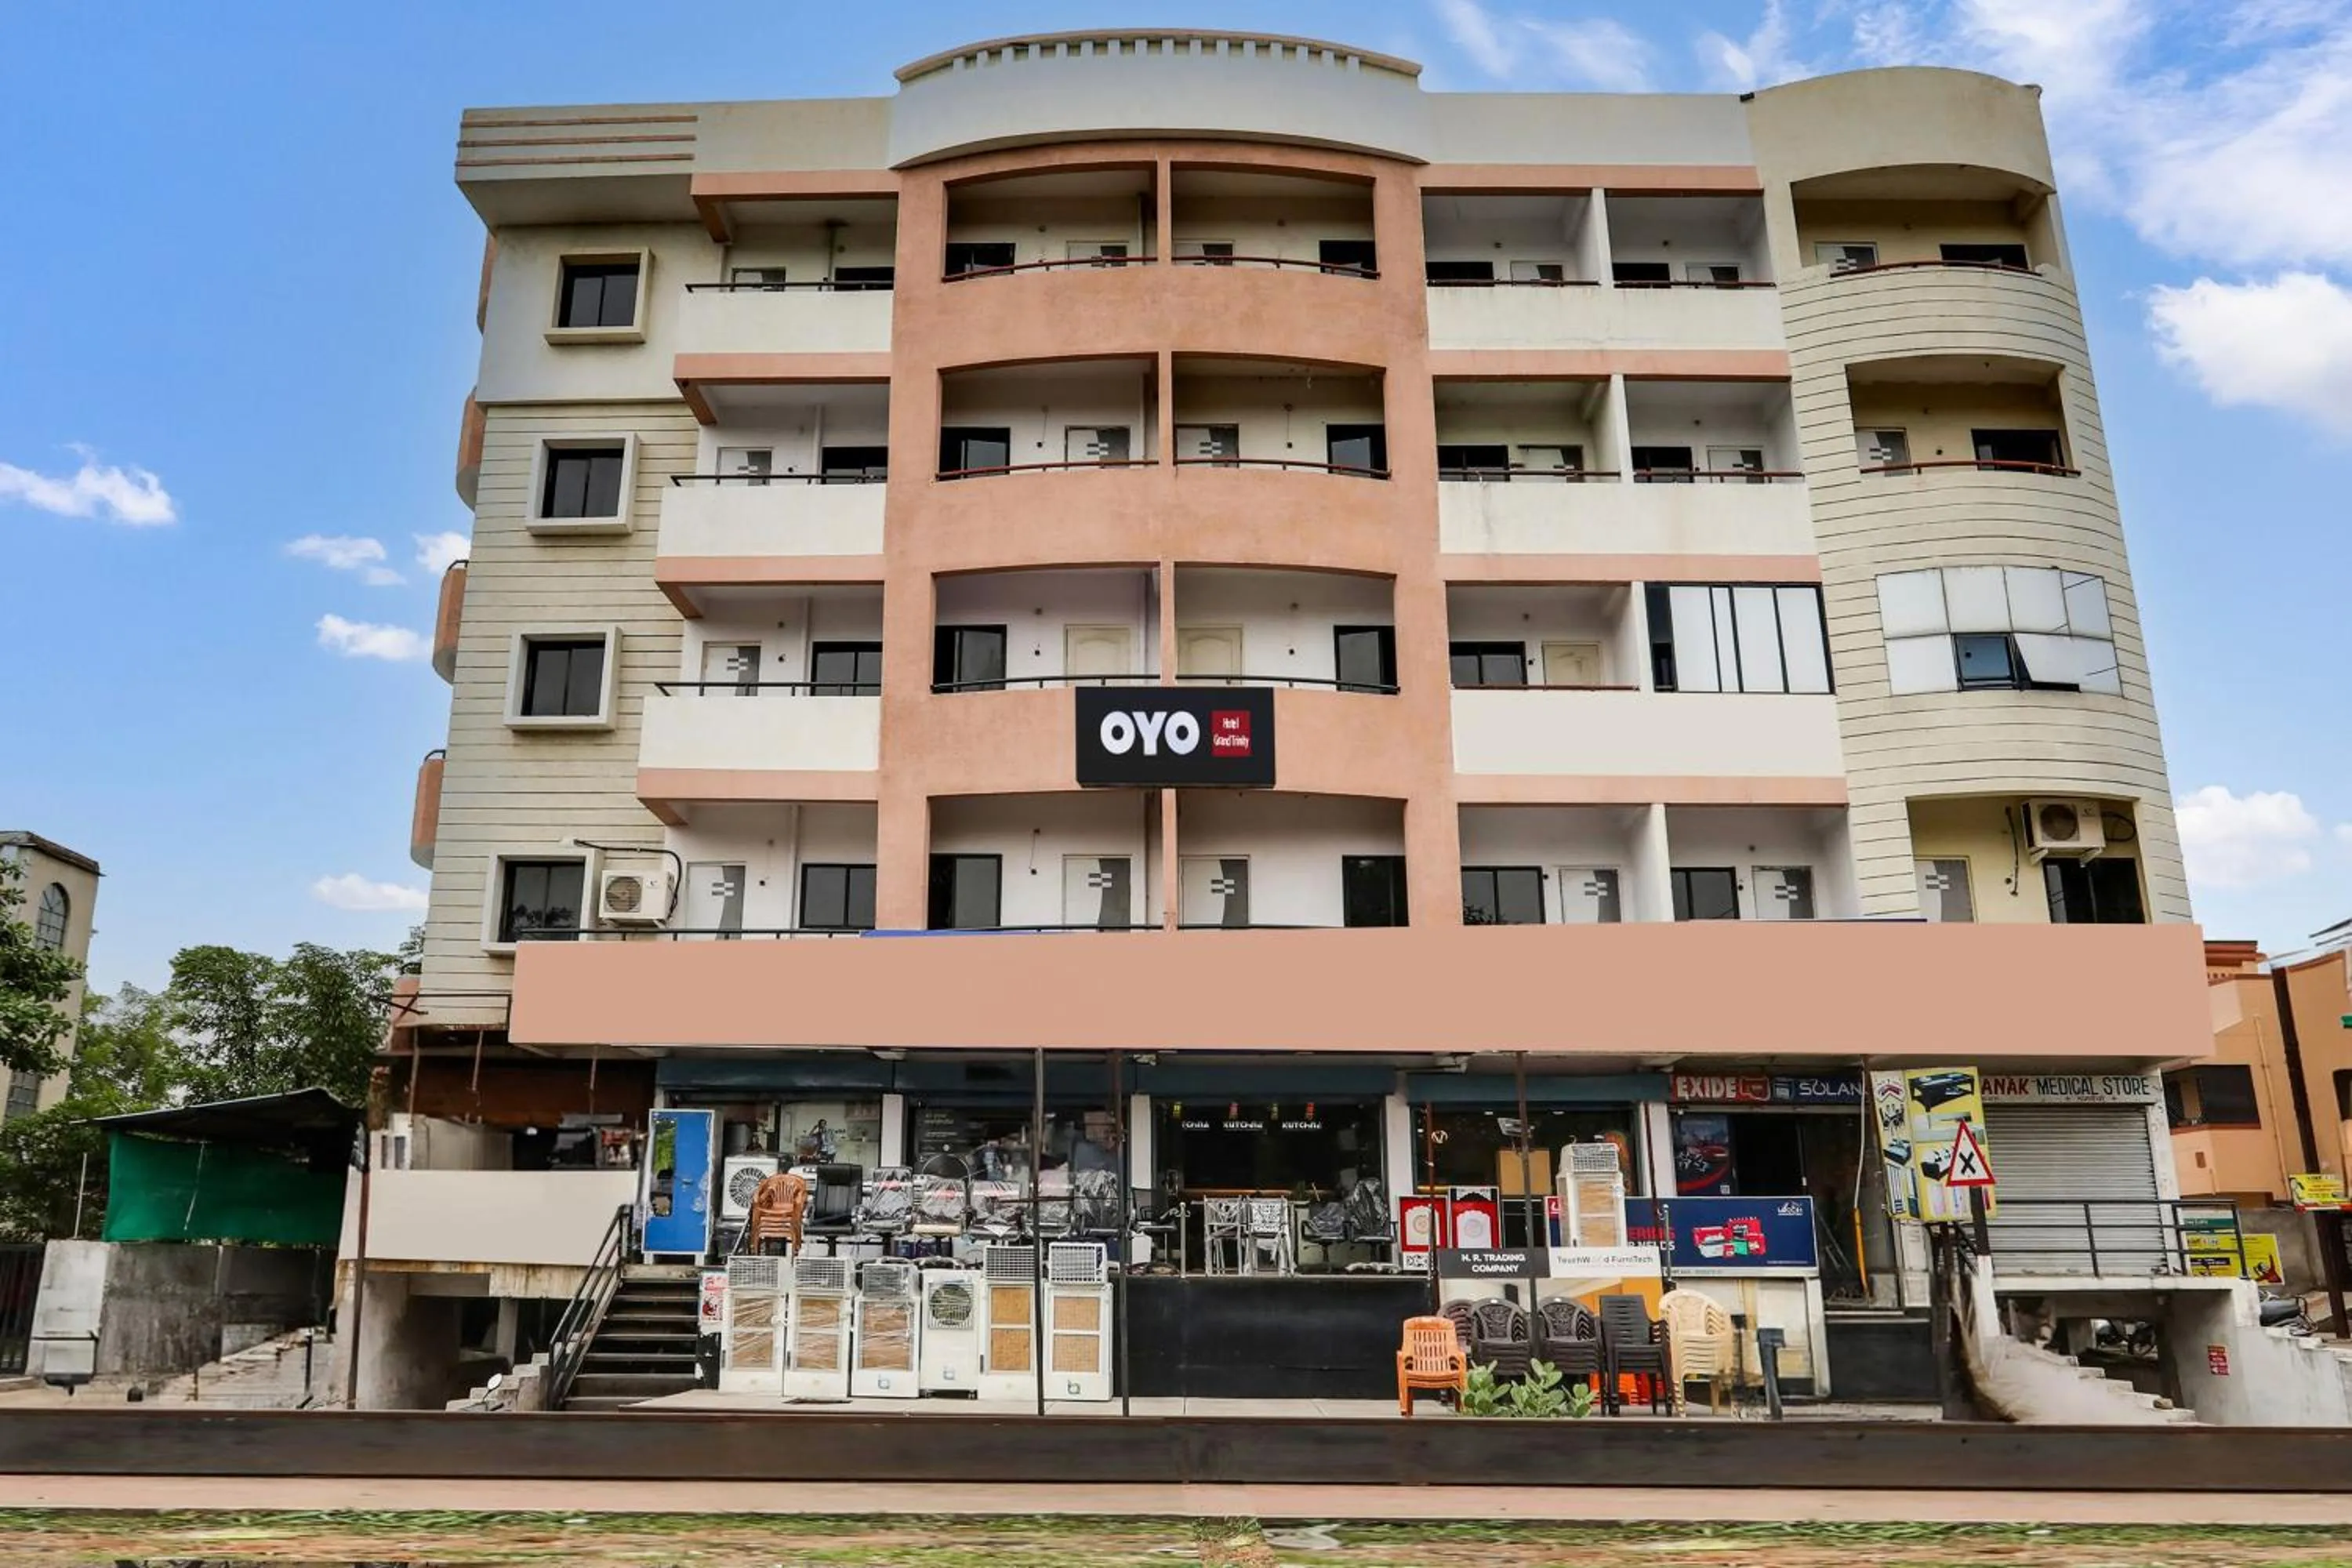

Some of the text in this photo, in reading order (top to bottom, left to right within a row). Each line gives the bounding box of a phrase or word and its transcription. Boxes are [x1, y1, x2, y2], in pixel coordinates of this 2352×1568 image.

[1100, 710, 1200, 755] OYO
[1222, 717, 1240, 729] Hotel
[1675, 1076, 1737, 1098] EXIDE
[2038, 1077, 2099, 1095] MEDICAL
[2103, 1076, 2151, 1095] STORE
[1472, 1264, 1519, 1272] COMPANY
